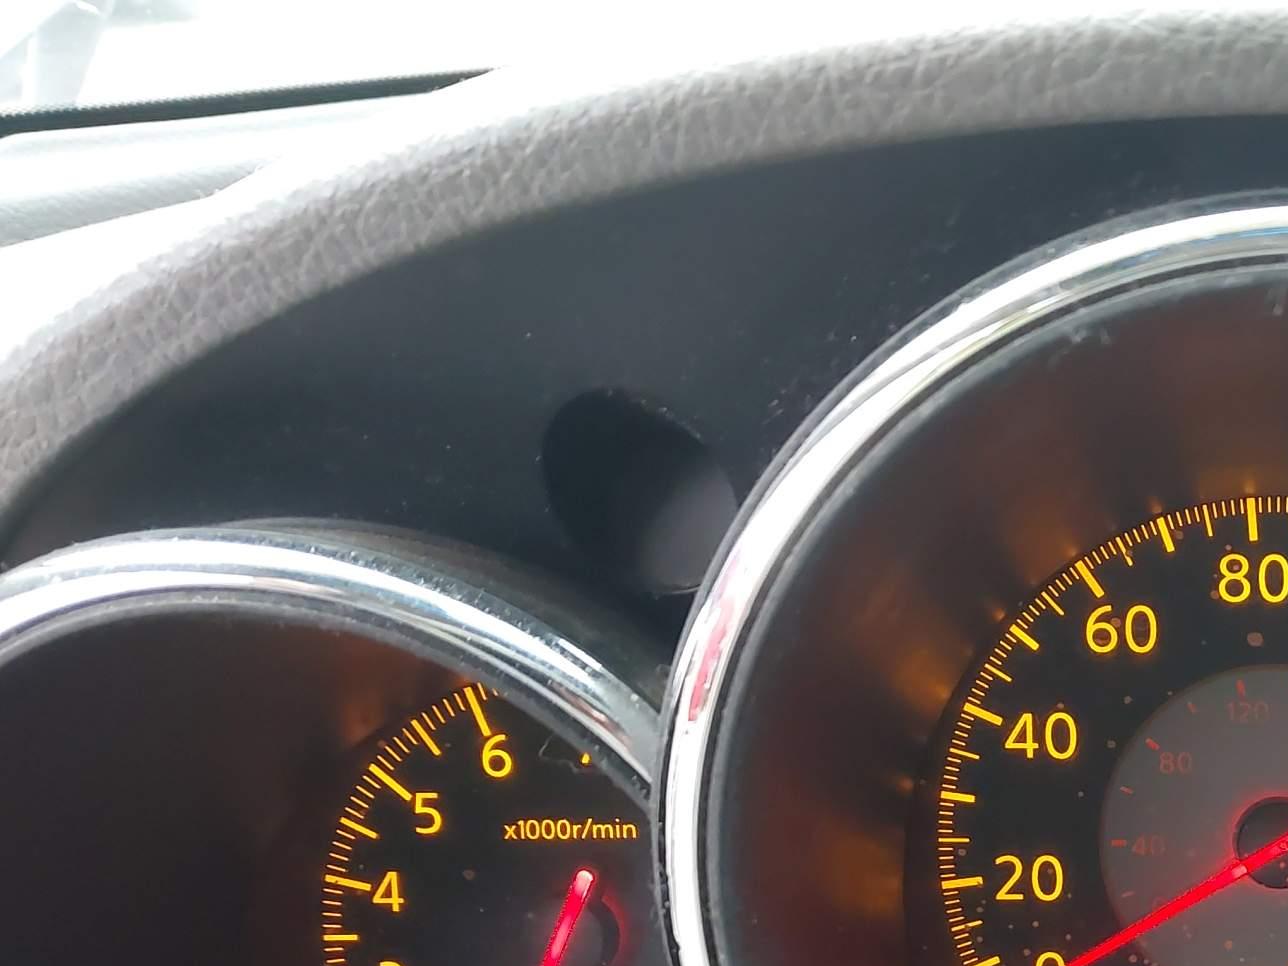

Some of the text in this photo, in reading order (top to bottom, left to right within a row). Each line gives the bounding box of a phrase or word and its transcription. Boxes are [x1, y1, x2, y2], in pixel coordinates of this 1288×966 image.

[1085, 604, 1158, 654] 60
[481, 734, 513, 778] 6
[1003, 712, 1079, 760] 40
[1158, 752, 1193, 775] 80
[414, 792, 443, 835] 5
[503, 818, 638, 841] x1000r/min
[372, 871, 405, 912] 4
[993, 854, 1065, 902] 20
